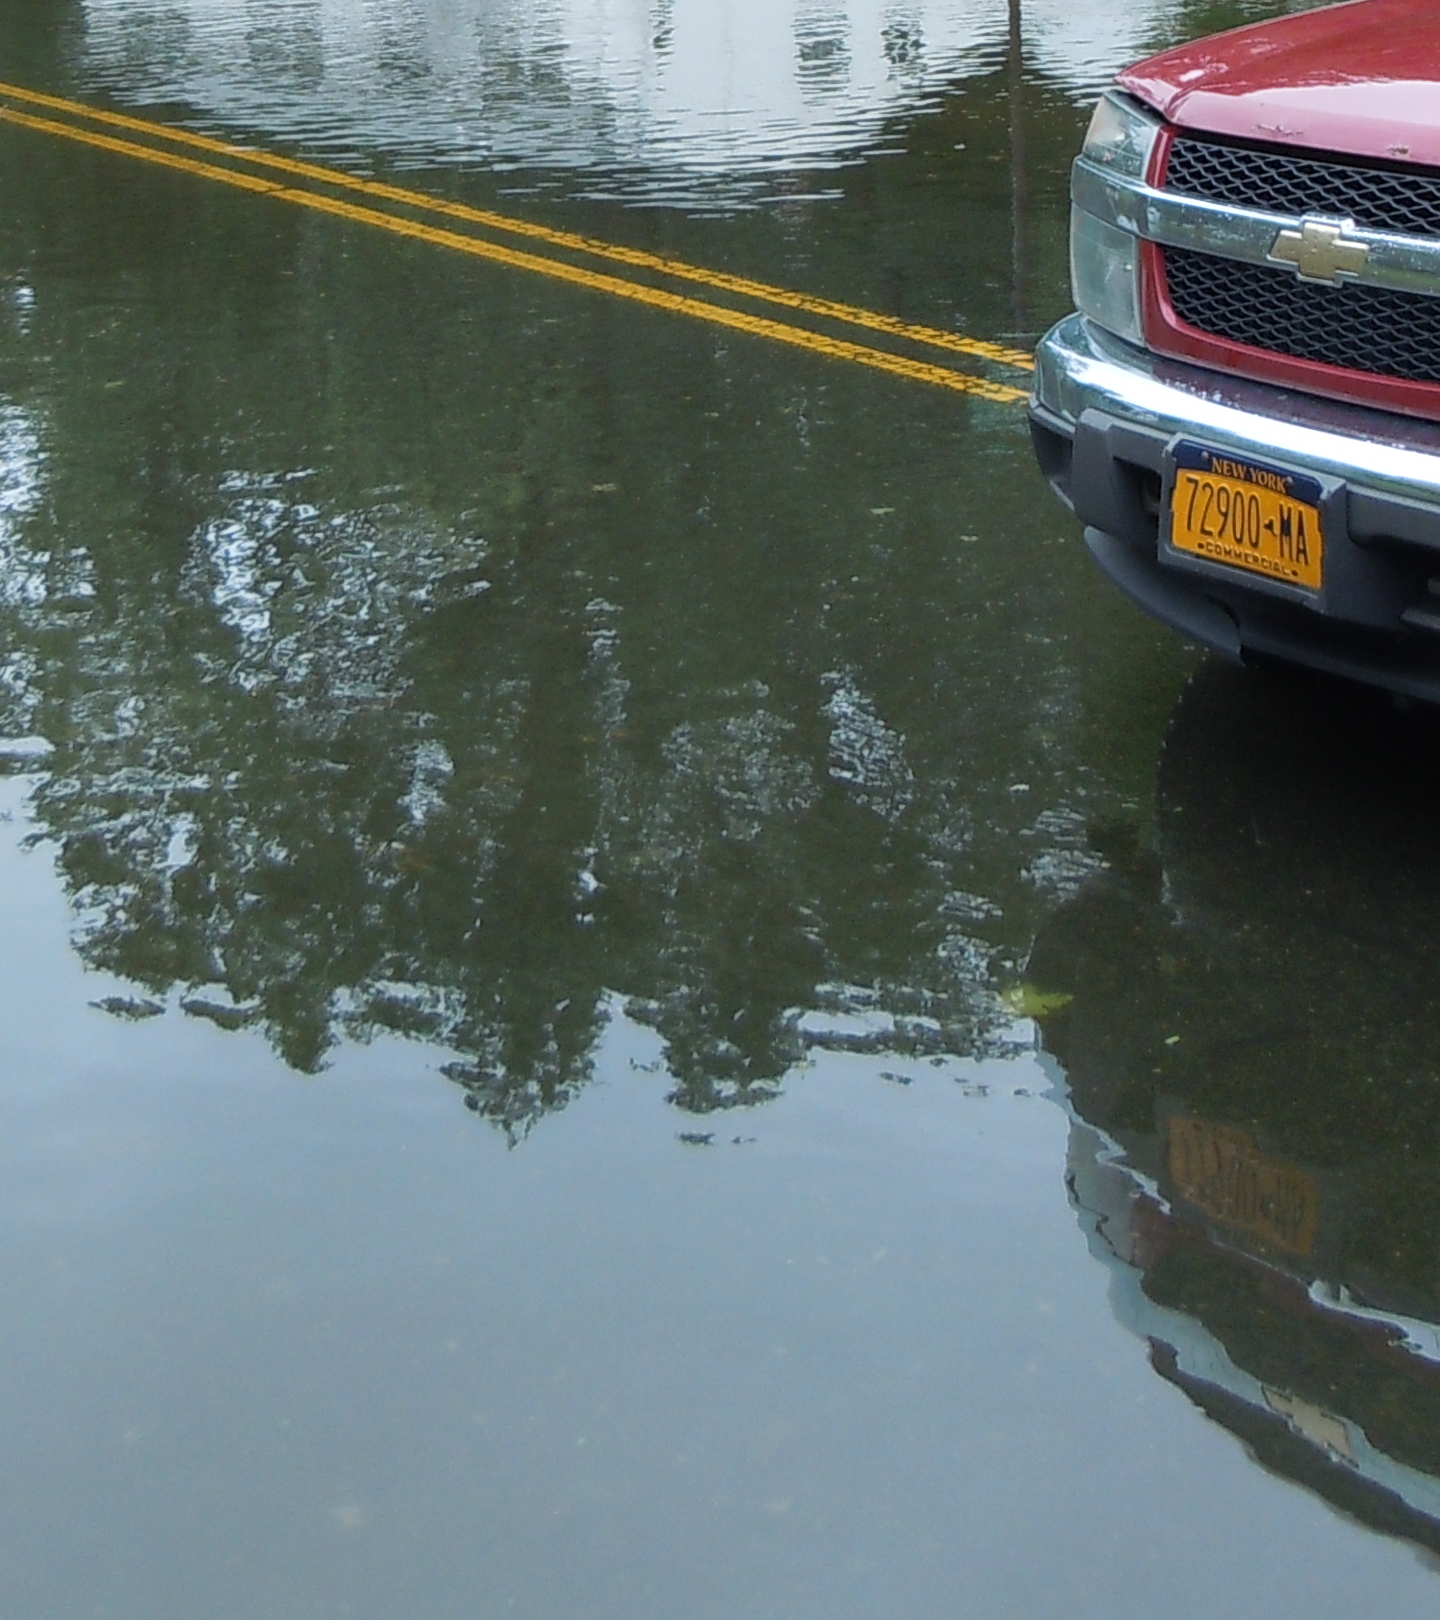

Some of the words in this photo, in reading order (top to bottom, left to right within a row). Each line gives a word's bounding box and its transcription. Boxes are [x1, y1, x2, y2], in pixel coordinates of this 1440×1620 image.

[1211, 457, 1247, 479] NEW
[1249, 467, 1288, 494] YORK
[1206, 541, 1290, 575] COMMERCIAL
